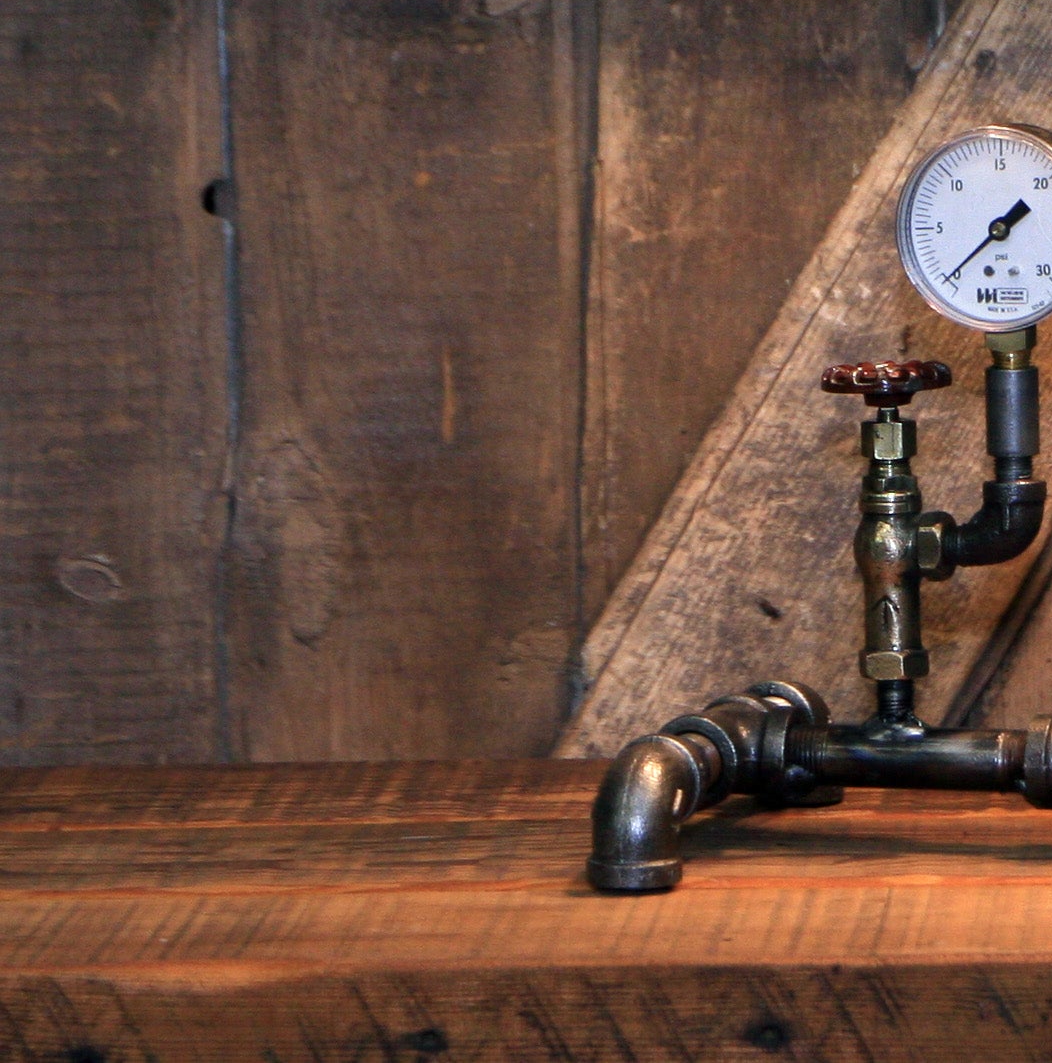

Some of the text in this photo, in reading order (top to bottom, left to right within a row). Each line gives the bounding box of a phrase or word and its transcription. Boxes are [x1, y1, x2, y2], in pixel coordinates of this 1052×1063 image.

[994, 158, 1006, 171] 15
[950, 179, 963, 192] 10
[1033, 177, 1049, 190] 20
[936, 222, 943, 233] 5
[995, 252, 1009, 262] psi
[1036, 264, 1051, 277] 30
